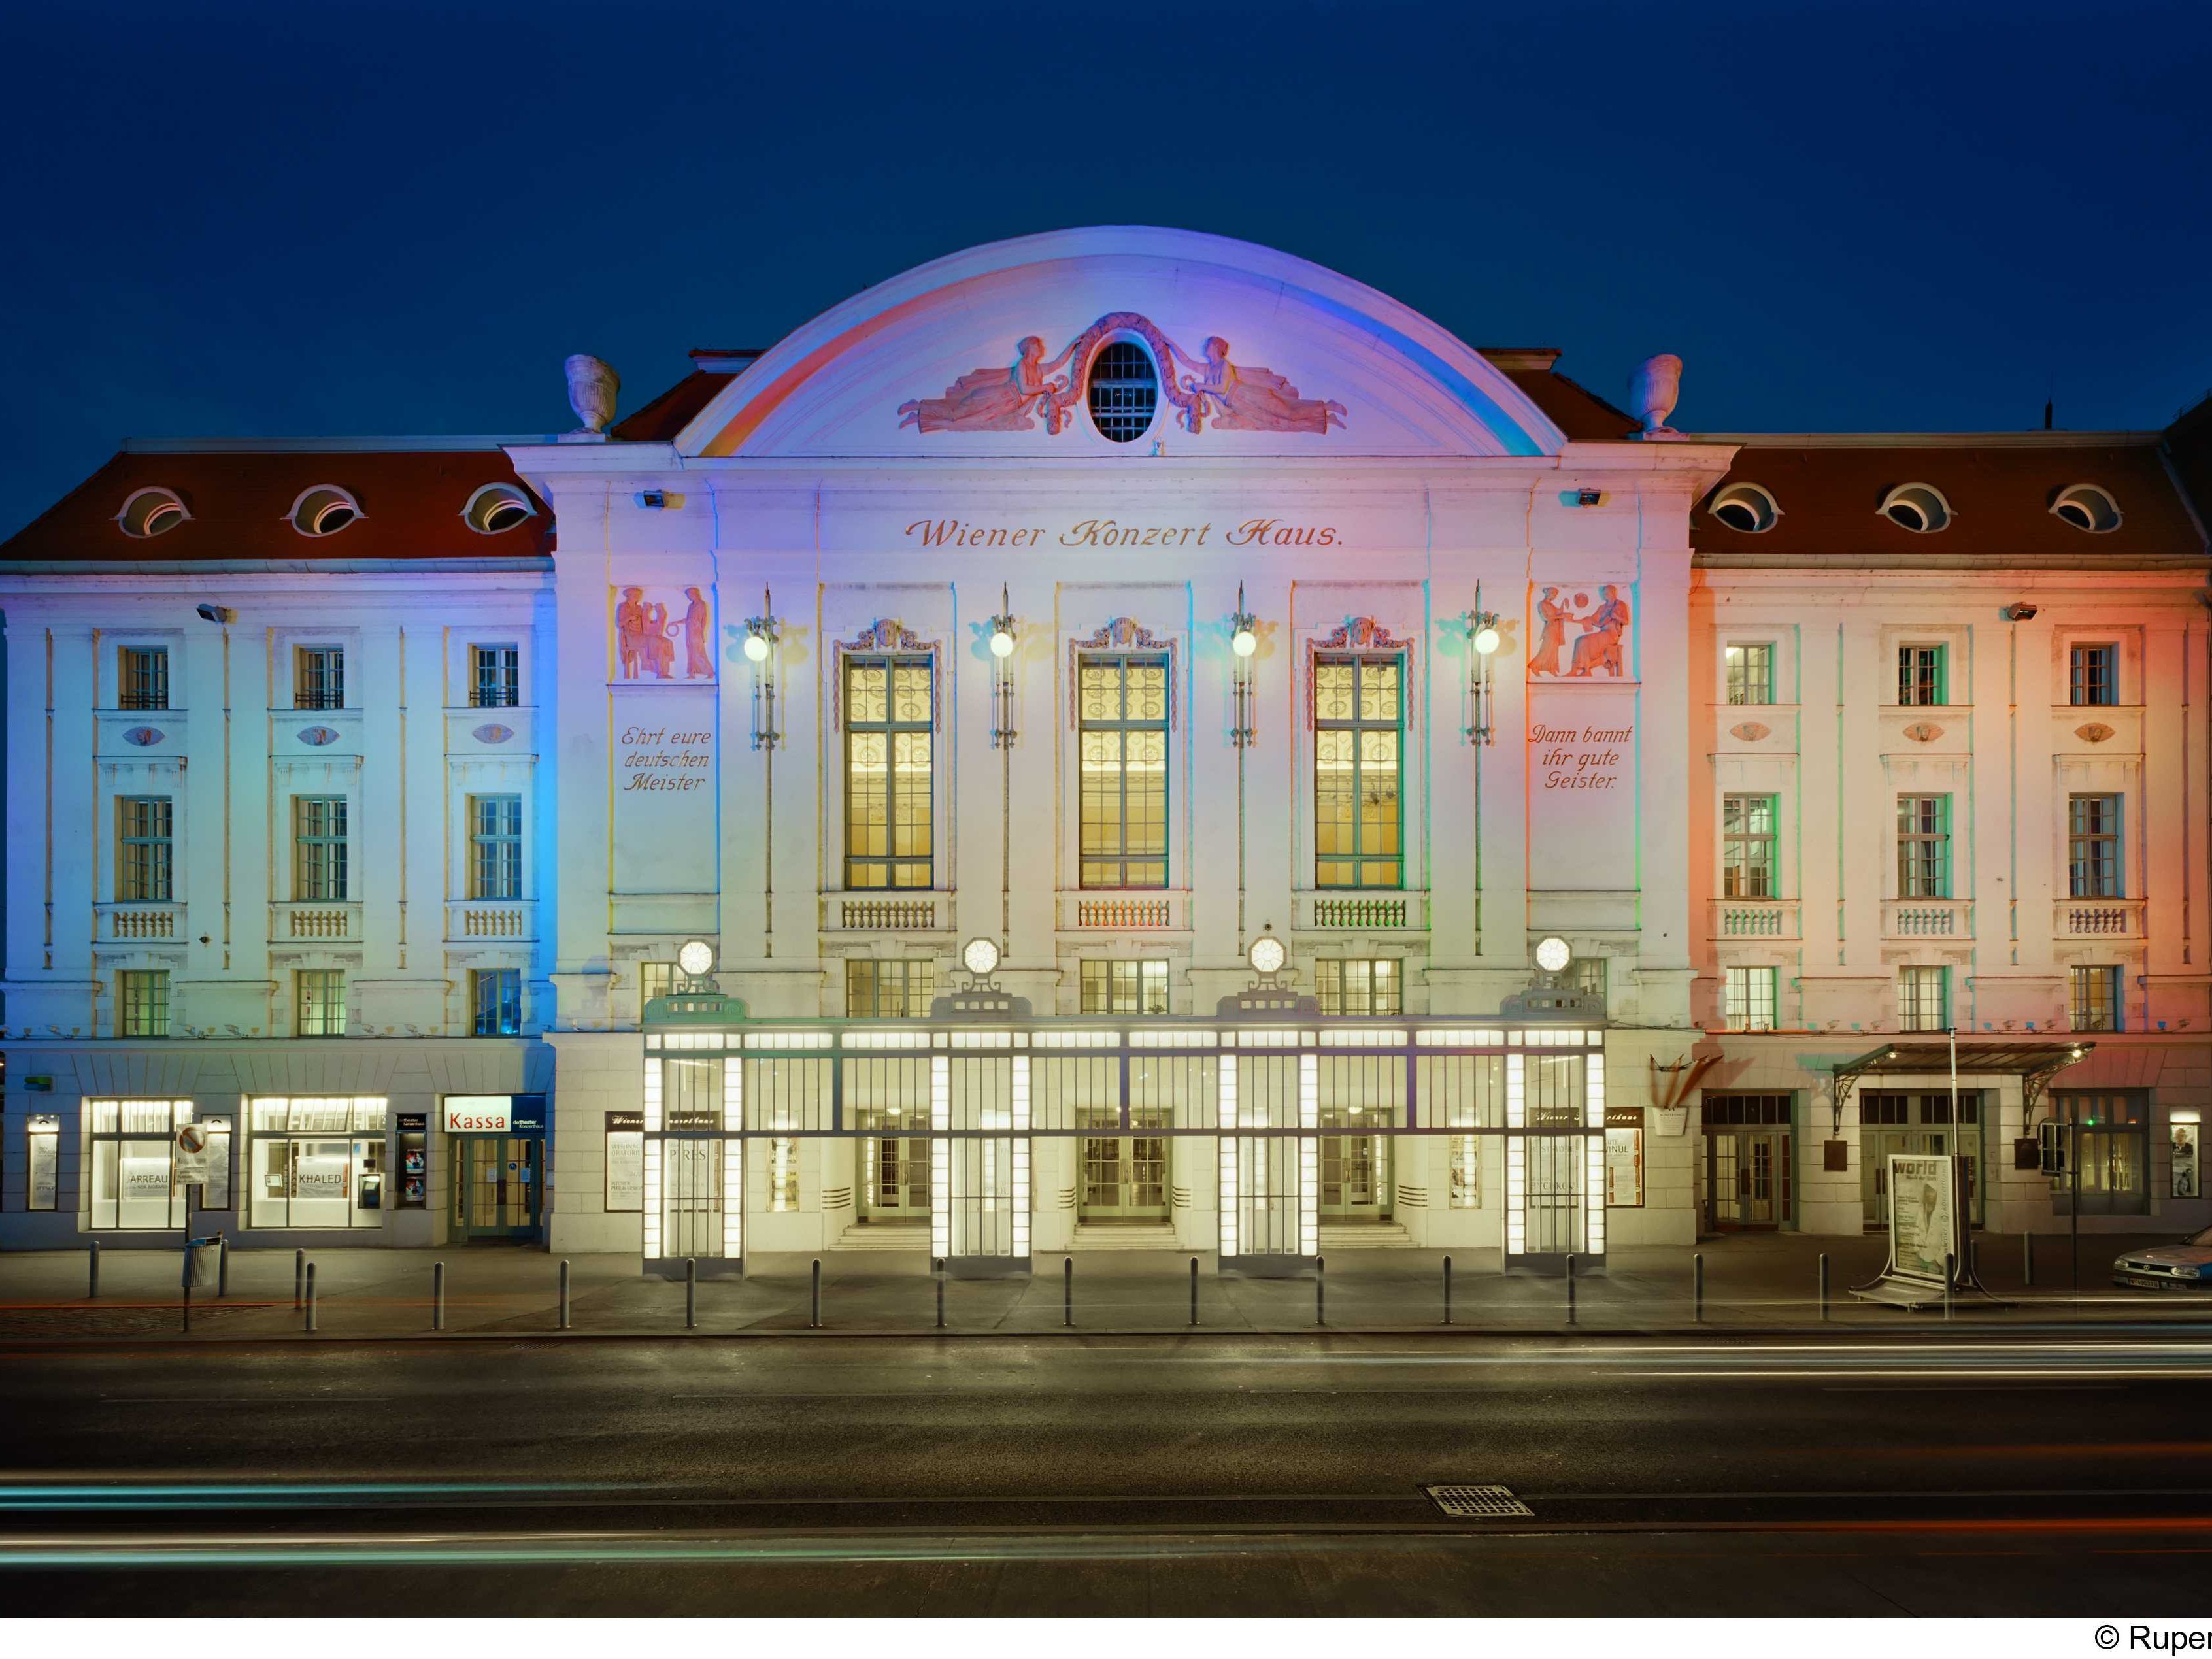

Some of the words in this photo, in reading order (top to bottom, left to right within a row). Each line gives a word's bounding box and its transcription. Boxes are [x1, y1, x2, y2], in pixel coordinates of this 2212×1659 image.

[906, 519, 1046, 547] Wiener
[1059, 519, 1211, 547] Konzert
[1226, 518, 1343, 546] Haus.
[622, 726, 665, 745] Ehrt
[671, 731, 712, 745] eure
[1528, 724, 1577, 743] Dann
[1582, 725, 1634, 743] bannt
[624, 750, 709, 769] deutschen
[1542, 748, 1573, 766] ihr
[1577, 748, 1620, 773] gute
[623, 773, 706, 791] Meister
[450, 1113, 505, 1129] Kassa
[670, 1149, 706, 1160] PRES
[1893, 1160, 1937, 1175] world
[299, 1174, 341, 1184] KHALED
